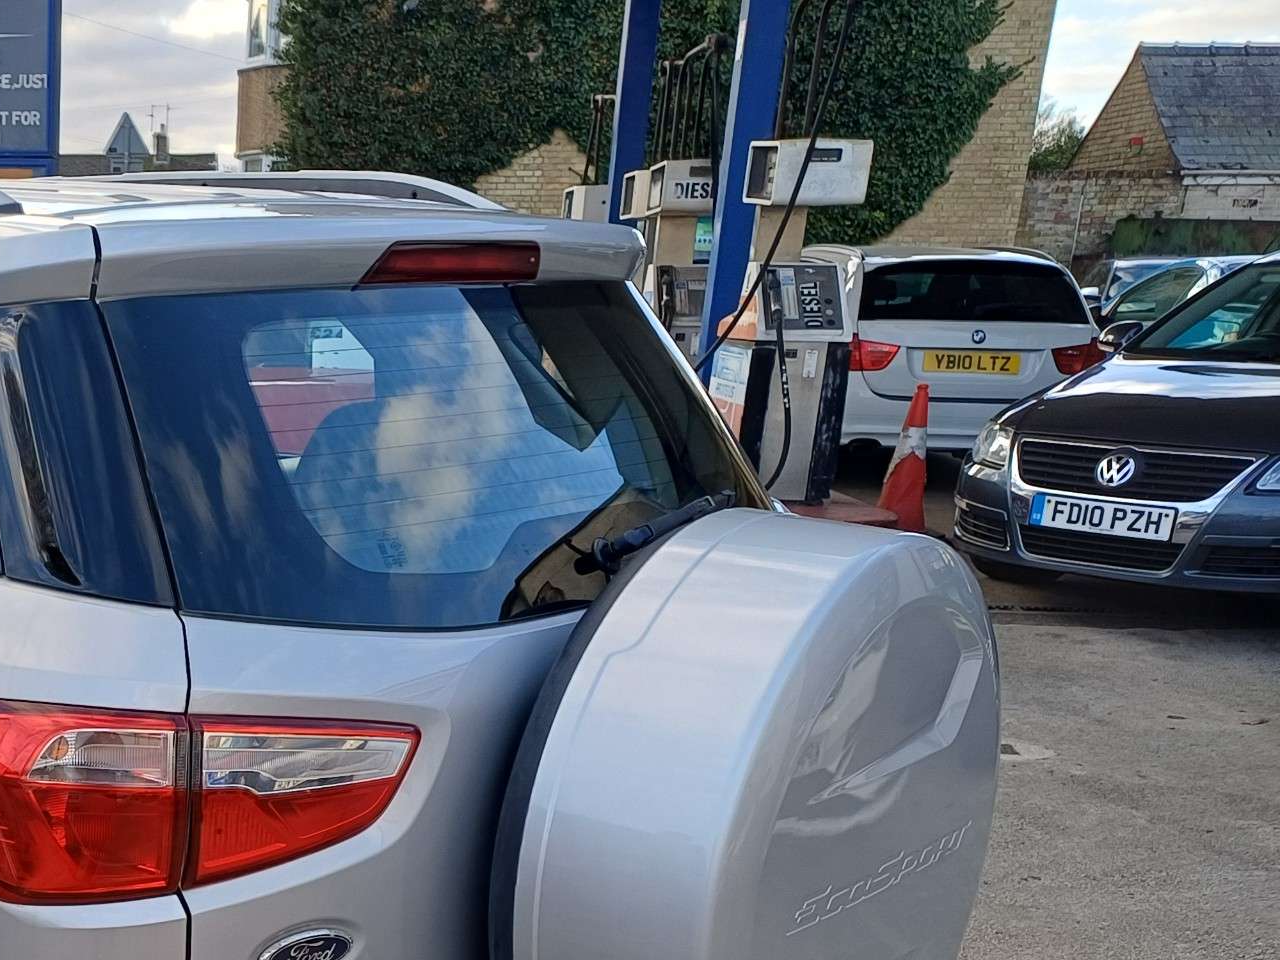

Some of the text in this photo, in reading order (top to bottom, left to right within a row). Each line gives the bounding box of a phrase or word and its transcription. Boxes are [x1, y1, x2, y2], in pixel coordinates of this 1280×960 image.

[12, 111, 40, 126] FOR
[674, 182, 713, 199] DIES
[799, 282, 824, 328] DIESEL
[935, 354, 1012, 372] YB10 LTZ
[1051, 500, 1163, 535] FD10 PZH
